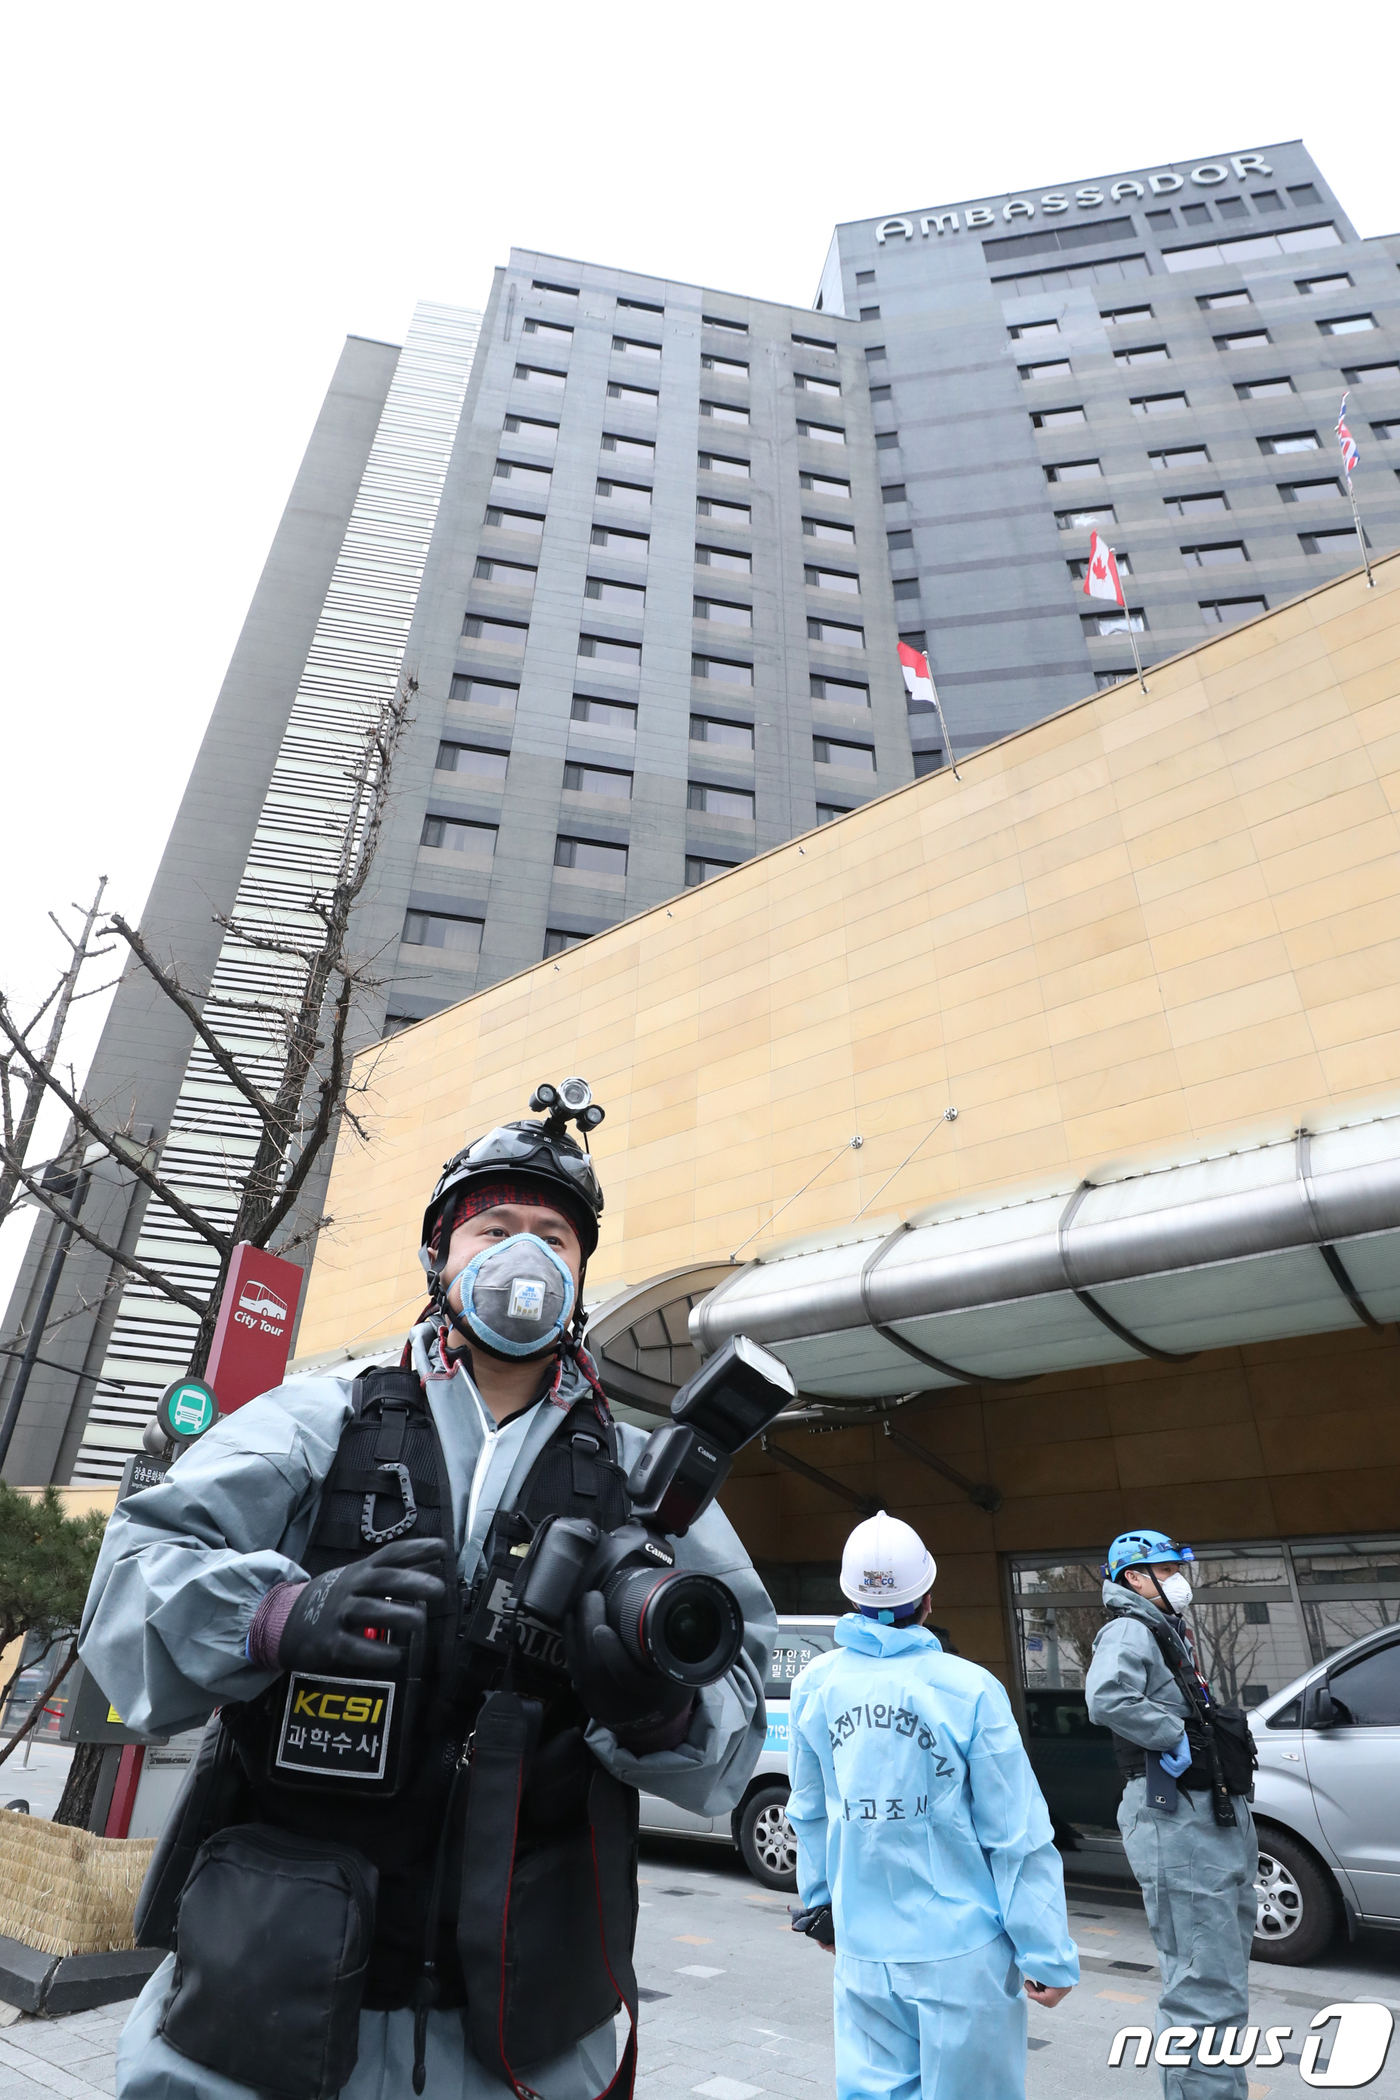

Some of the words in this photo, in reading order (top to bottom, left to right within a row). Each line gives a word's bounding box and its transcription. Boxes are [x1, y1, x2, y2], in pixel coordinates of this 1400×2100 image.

[875, 153, 1273, 244] AMBASSADOR
[234, 1310, 258, 1329] City
[260, 1319, 284, 1337] Tour
[697, 1446, 717, 1462] Canon
[644, 1543, 673, 1565] Canon
[486, 1613, 568, 1669] POLIC
[293, 1690, 383, 1724] KCSI
[287, 1725, 380, 1758] 과학수사
